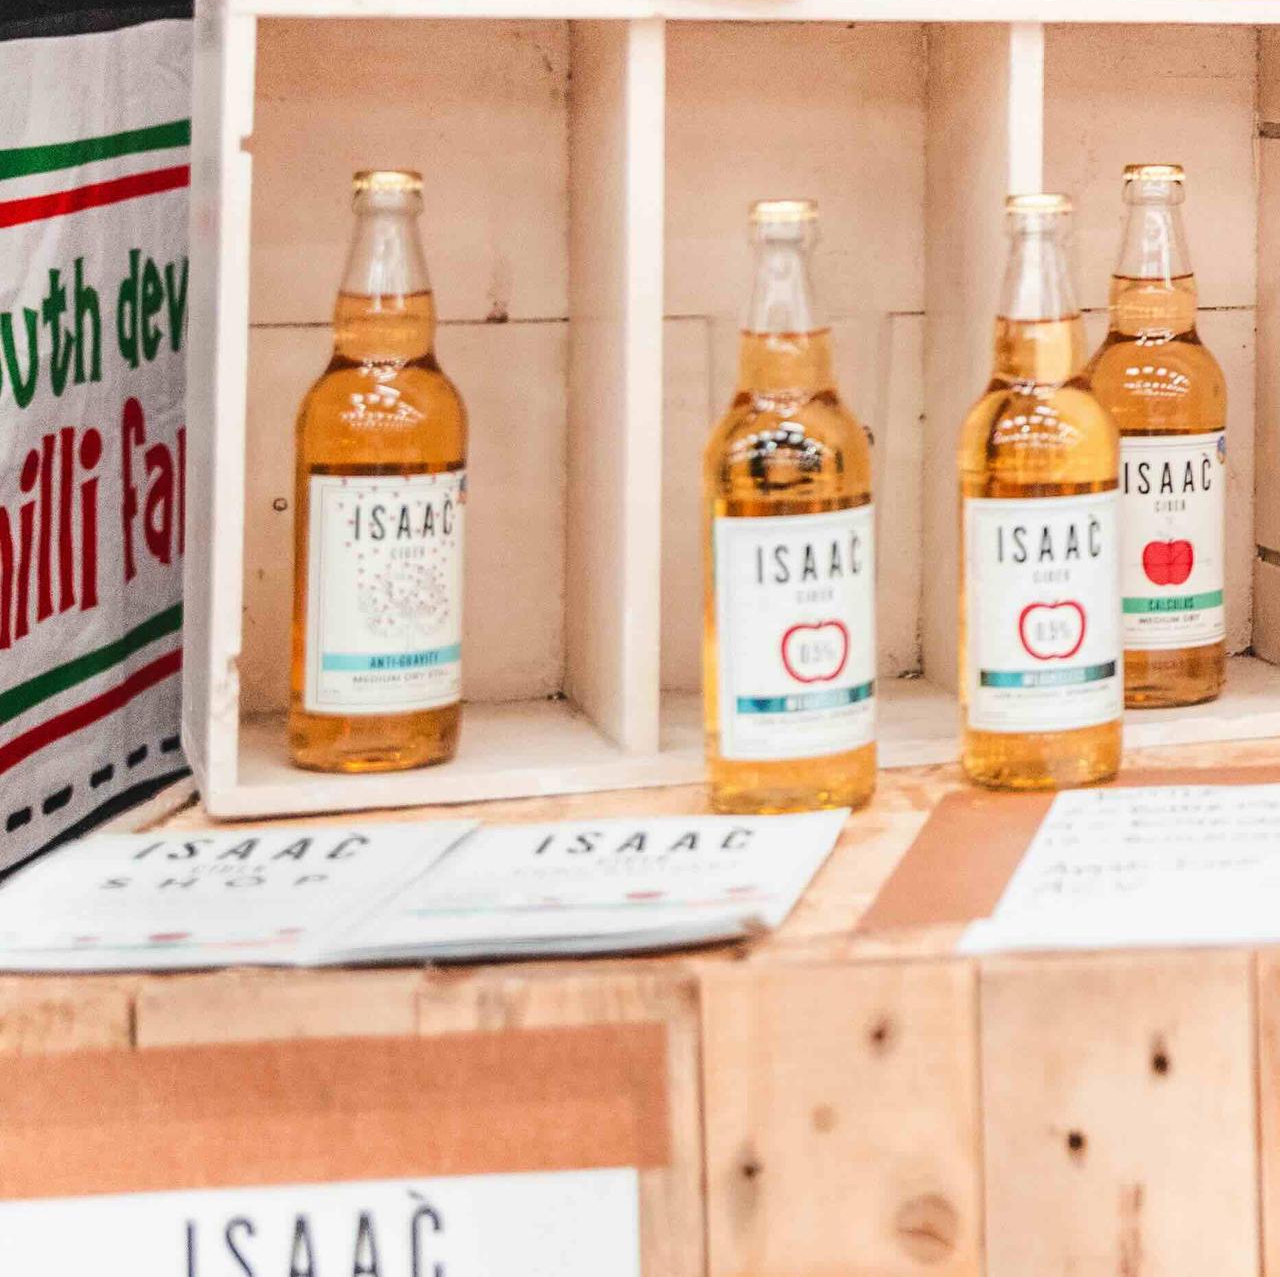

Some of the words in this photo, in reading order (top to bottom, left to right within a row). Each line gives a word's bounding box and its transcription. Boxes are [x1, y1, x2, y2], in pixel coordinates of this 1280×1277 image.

[0, 257, 103, 410] uth
[0, 426, 103, 642] illi
[368, 650, 440, 669] ANTI-GRAVITY
[99, 874, 330, 890] SHOP
